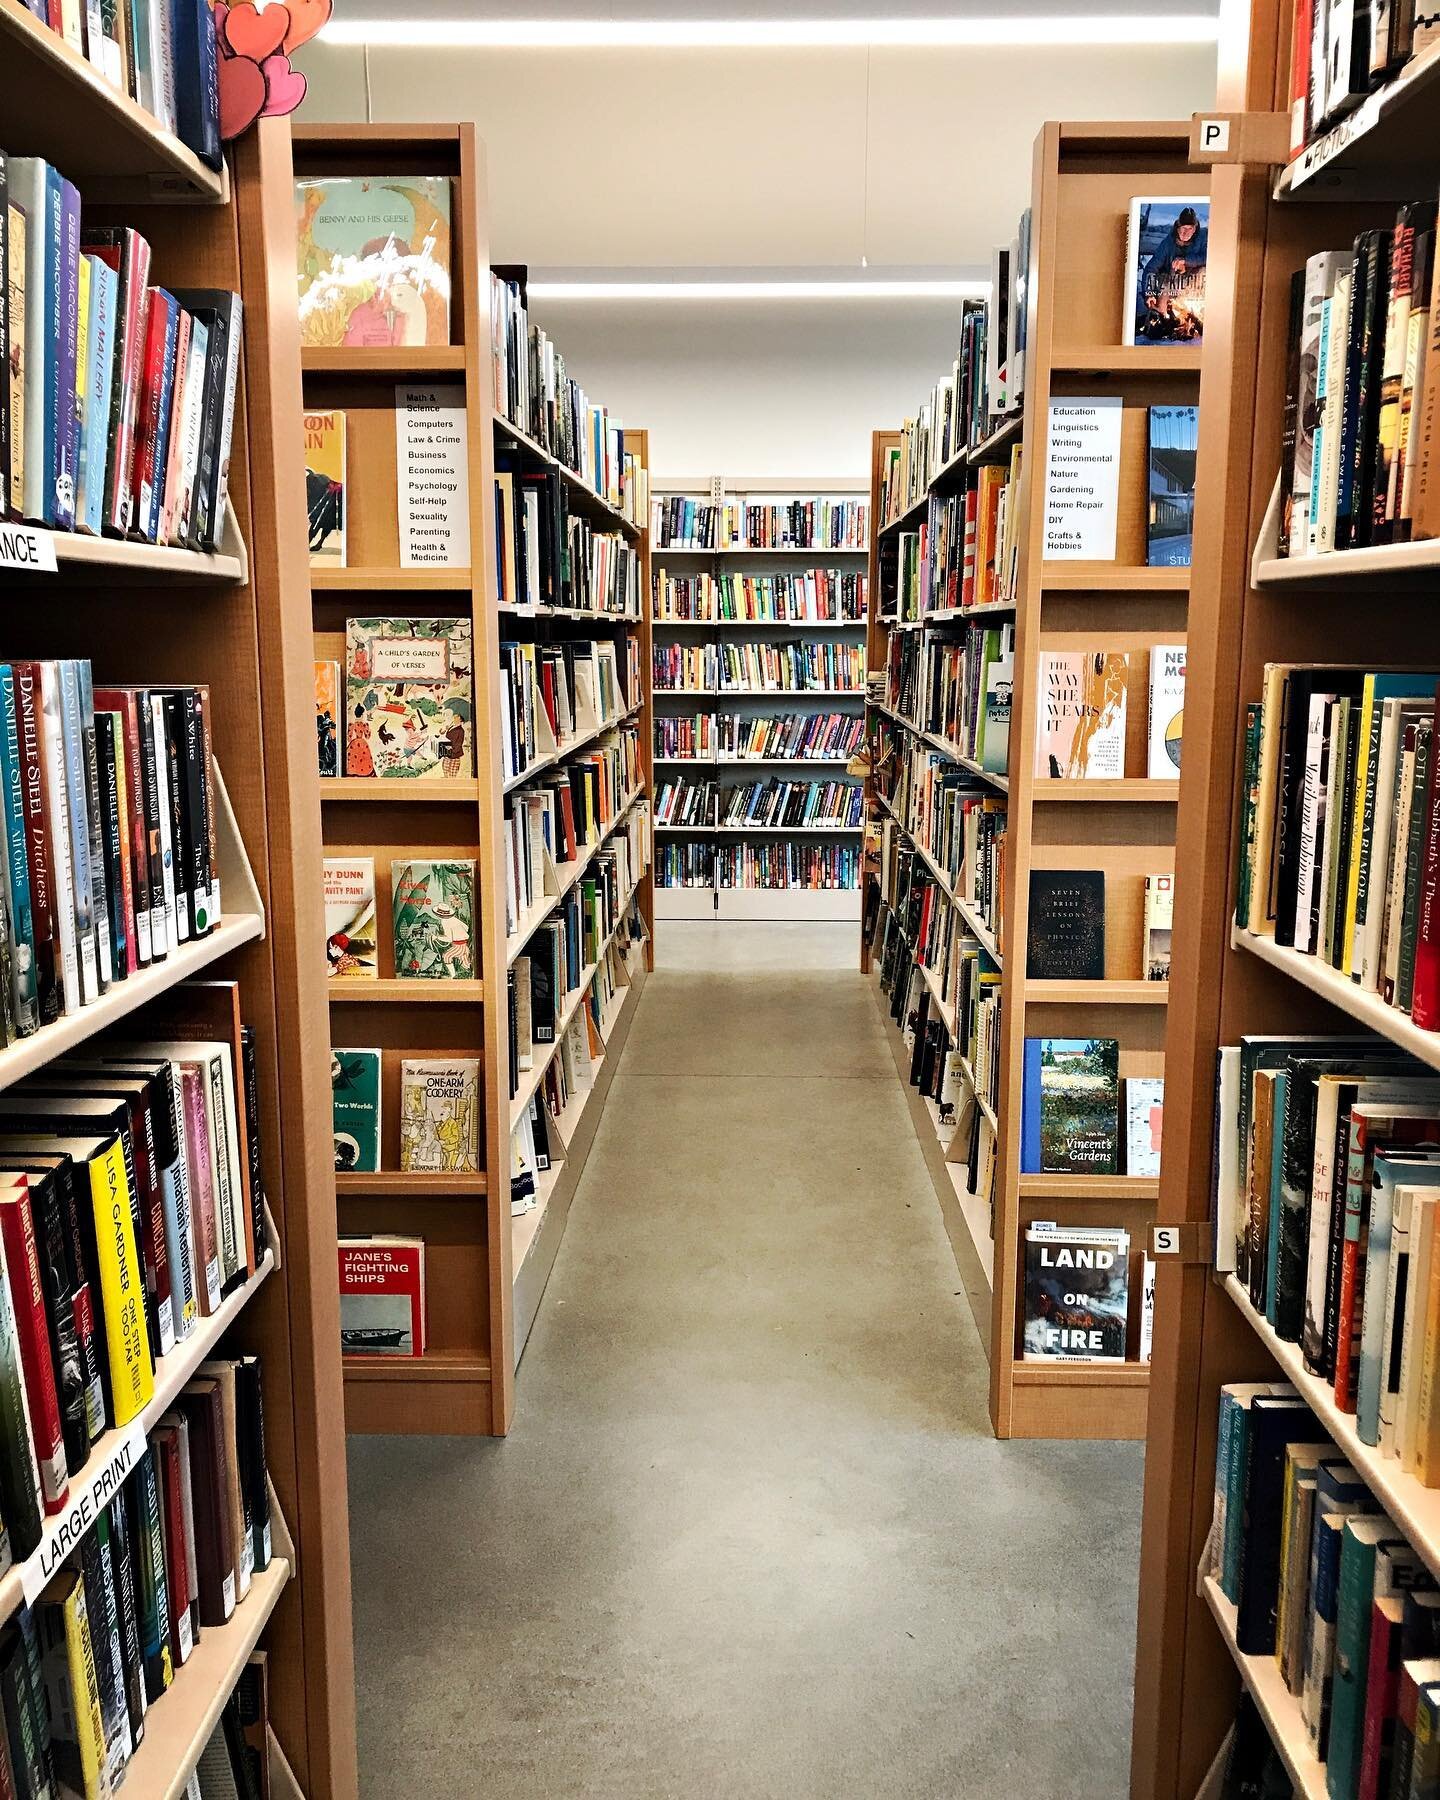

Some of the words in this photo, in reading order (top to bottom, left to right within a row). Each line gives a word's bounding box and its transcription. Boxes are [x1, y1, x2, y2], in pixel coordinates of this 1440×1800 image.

[161, 37, 169, 65] AND
[162, 70, 170, 109] ASHES
[1205, 125, 1220, 146] P
[53, 189, 61, 247] DEBBIE
[319, 216, 345, 224] BENNY
[383, 215, 409, 223] GEESE
[68, 212, 76, 269] DEBBIE
[66, 271, 76, 358] MACOMBER
[97, 268, 108, 327] SUSAN
[1347, 258, 1360, 346] Bewilderment
[1321, 306, 1330, 343] BLUE
[95, 329, 106, 403] MALLERY
[1318, 349, 1328, 397] ANGEL
[12, 392, 21, 463] KIRKPATRICK
[407, 420, 453, 428] Computers
[1053, 408, 1095, 416] Education
[1053, 424, 1099, 432] Linguistics
[1424, 386, 1436, 442] STEVEN
[1052, 439, 1082, 448] Writing
[409, 482, 457, 491] Psychology
[1050, 486, 1094, 494] Gardening
[1337, 445, 1346, 506] POWERS
[1419, 450, 1430, 497] PRICE
[409, 498, 447, 506] Self-Help
[409, 513, 448, 521] Sexuality
[1077, 501, 1103, 509] Repair
[410, 528, 450, 537] Parenting
[411, 553, 448, 561] Medicine
[1049, 674, 1079, 686] WAY
[1050, 662, 1070, 670] THE
[186, 696, 193, 718] DL
[1048, 689, 1078, 701] SHE
[1048, 705, 1100, 716] WEARS
[2, 676, 19, 764] DANIELLE
[19, 675, 38, 762] DANIELLE
[1047, 720, 1062, 732] IT
[1369, 710, 1380, 755] ELIZA
[188, 720, 197, 760] White
[88, 726, 100, 807] DANIELLE
[147, 756, 156, 774] KIKI
[10, 767, 24, 823] STEEL
[27, 764, 41, 819] STEEL
[56, 737, 68, 834] DANIELLE
[107, 762, 118, 822] DANIELLE
[148, 777, 159, 821] SWINSON
[1302, 762, 1319, 830] Marilynne
[1364, 759, 1376, 819] STARTS
[112, 825, 120, 859] STEEL
[1362, 824, 1371, 833] A
[13, 849, 23, 888] Odds
[194, 843, 203, 866] The
[1297, 832, 1314, 896] Robinson
[1357, 837, 1370, 899] RUMOR
[1421, 877, 1438, 942] Theater
[426, 1088, 464, 1098] COOKERY
[427, 1078, 464, 1087] ONE-ARM
[143, 1108, 154, 1150] ROBERT
[1066, 1138, 1112, 1149] Vincent's
[1338, 1128, 1347, 1154] The
[147, 1150, 158, 1192] HARRIS
[251, 1135, 261, 1173] FOX
[1069, 1150, 1112, 1162] Gardens
[121, 1130, 135, 1189] UNTIL
[129, 1192, 139, 1224] THE
[220, 1178, 230, 1205] DEMON
[19, 1200, 33, 1239] Janet
[106, 1155, 118, 1200] LISA
[112, 1203, 130, 1294] GARDNER
[254, 1179, 264, 1242] CREEK
[1333, 1190, 1342, 1239] Moved
[149, 1201, 167, 1273] CONCLAVE
[169, 1164, 187, 1227] Jonathan
[178, 1228, 194, 1305] Kellerman
[1158, 1231, 1171, 1248] S
[25, 1240, 43, 1307] Evanovich
[345, 1252, 392, 1261] JANE'S
[345, 1264, 408, 1272] FIGHTING
[1040, 1248, 1114, 1269] LAND
[346, 1274, 385, 1282] SHIPS
[128, 1297, 138, 1326] ONE
[1063, 1294, 1088, 1306] ON
[80, 1310, 94, 1348] LIAR'S
[120, 1304, 131, 1337] TOO
[1046, 1329, 1103, 1350] FIRE
[124, 1340, 134, 1366] FAR
[130, 1328, 142, 1358] STEP
[1222, 1400, 1231, 1426] JILL
[1233, 1410, 1241, 1434] JILL
[1219, 1428, 1229, 1482] SHALVIS
[1230, 1440, 1239, 1494] SHALVIS
[40, 1495, 92, 1579] LARGE
[92, 1440, 132, 1509] PRINT
[146, 1478, 158, 1525] SCOTT
[103, 1585, 117, 1627] SMITH
[119, 1555, 131, 1623] DANIELLE
[81, 1621, 99, 1709] SCOTTOLINE
